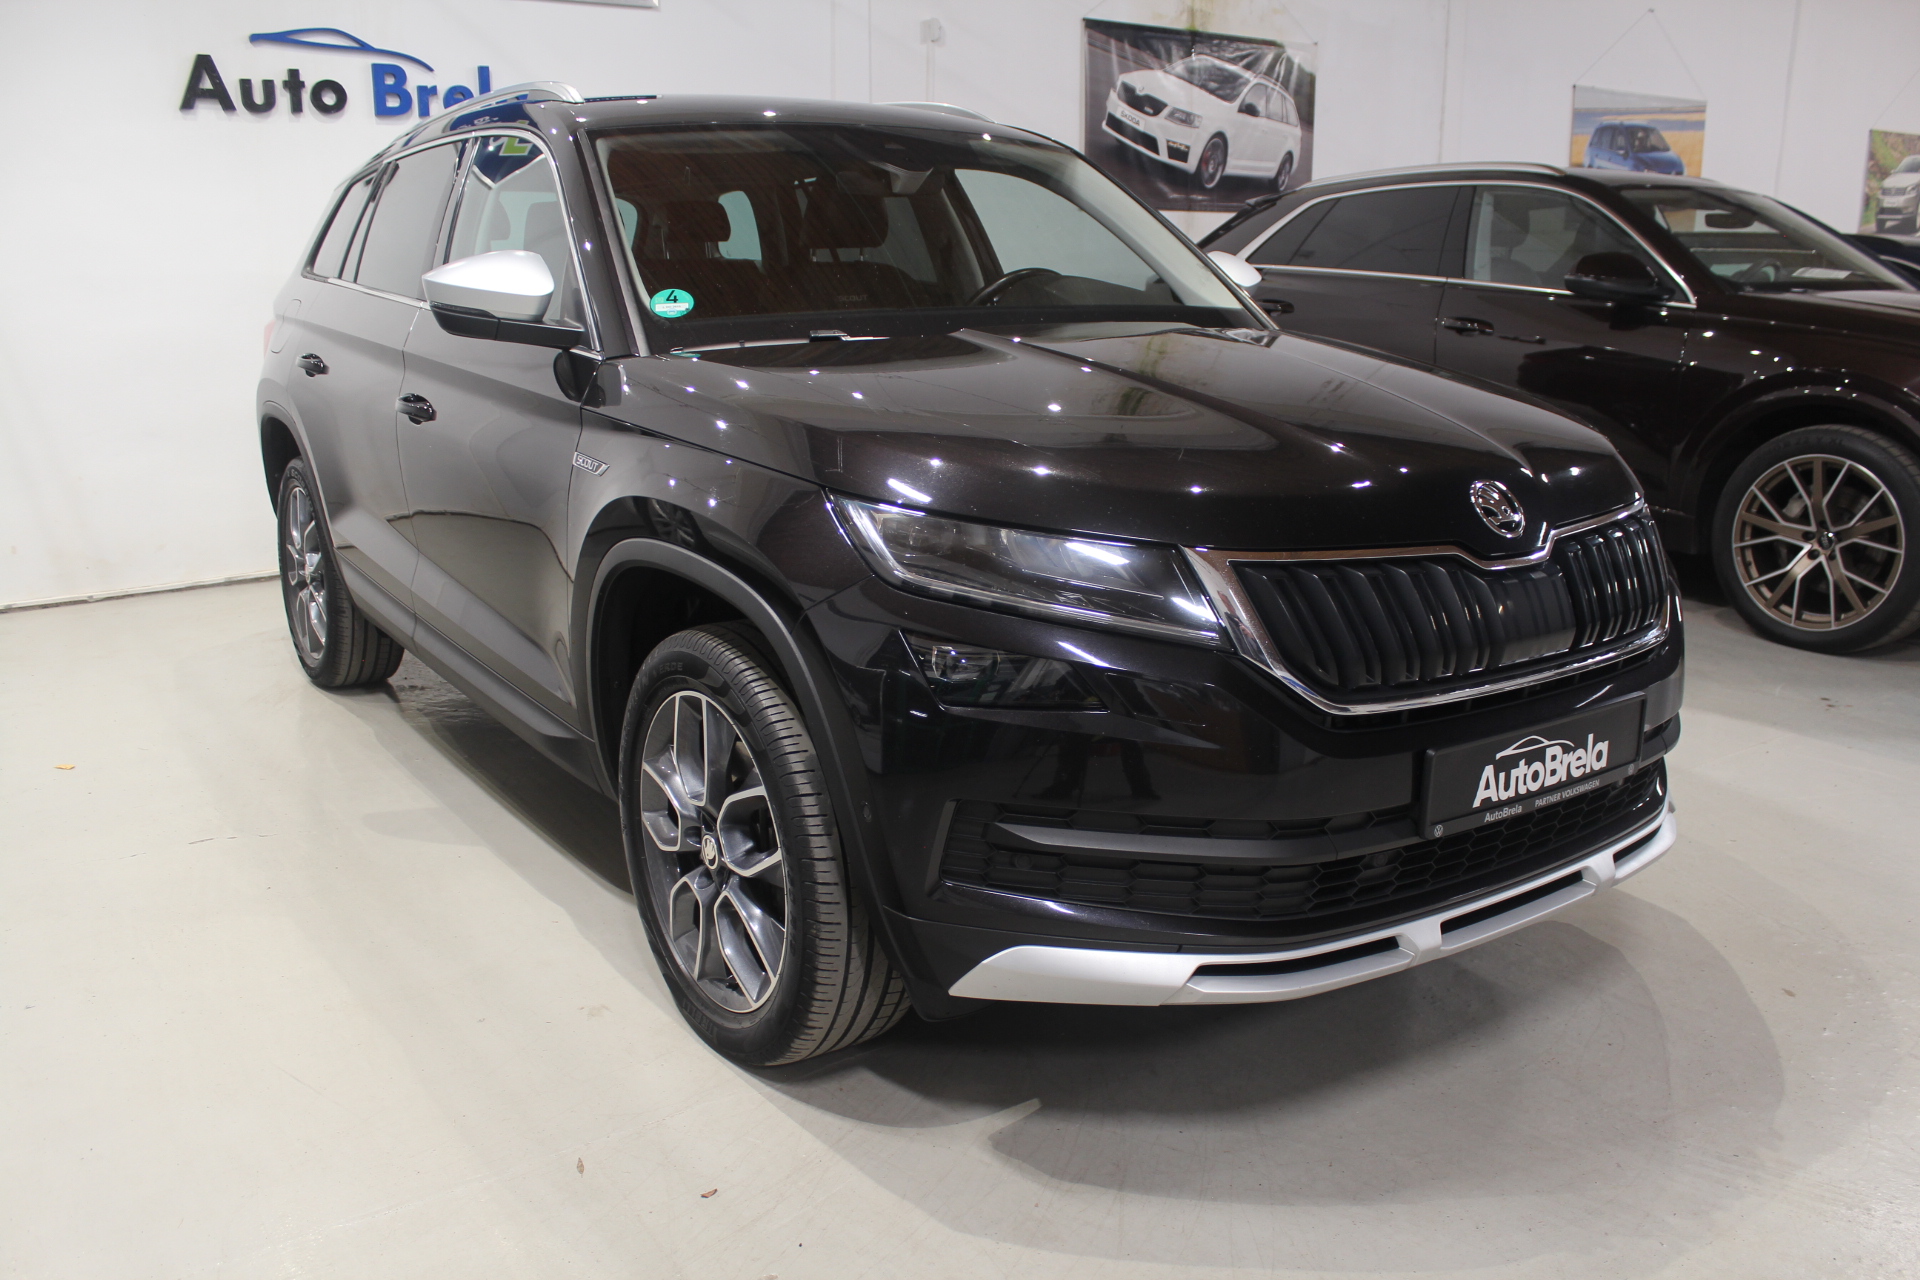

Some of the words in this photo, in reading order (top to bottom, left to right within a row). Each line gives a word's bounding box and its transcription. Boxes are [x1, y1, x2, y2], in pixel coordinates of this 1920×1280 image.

[180, 54, 348, 115] Auto
[371, 63, 491, 118] Brel
[666, 290, 679, 303] 4
[576, 455, 599, 471] SCOUT
[1472, 733, 1609, 808] AutoBrela
[1484, 804, 1522, 823] AutoBrela
[1535, 793, 1561, 807] PARTNER
[1562, 779, 1600, 799] VOLKSWAGEN
